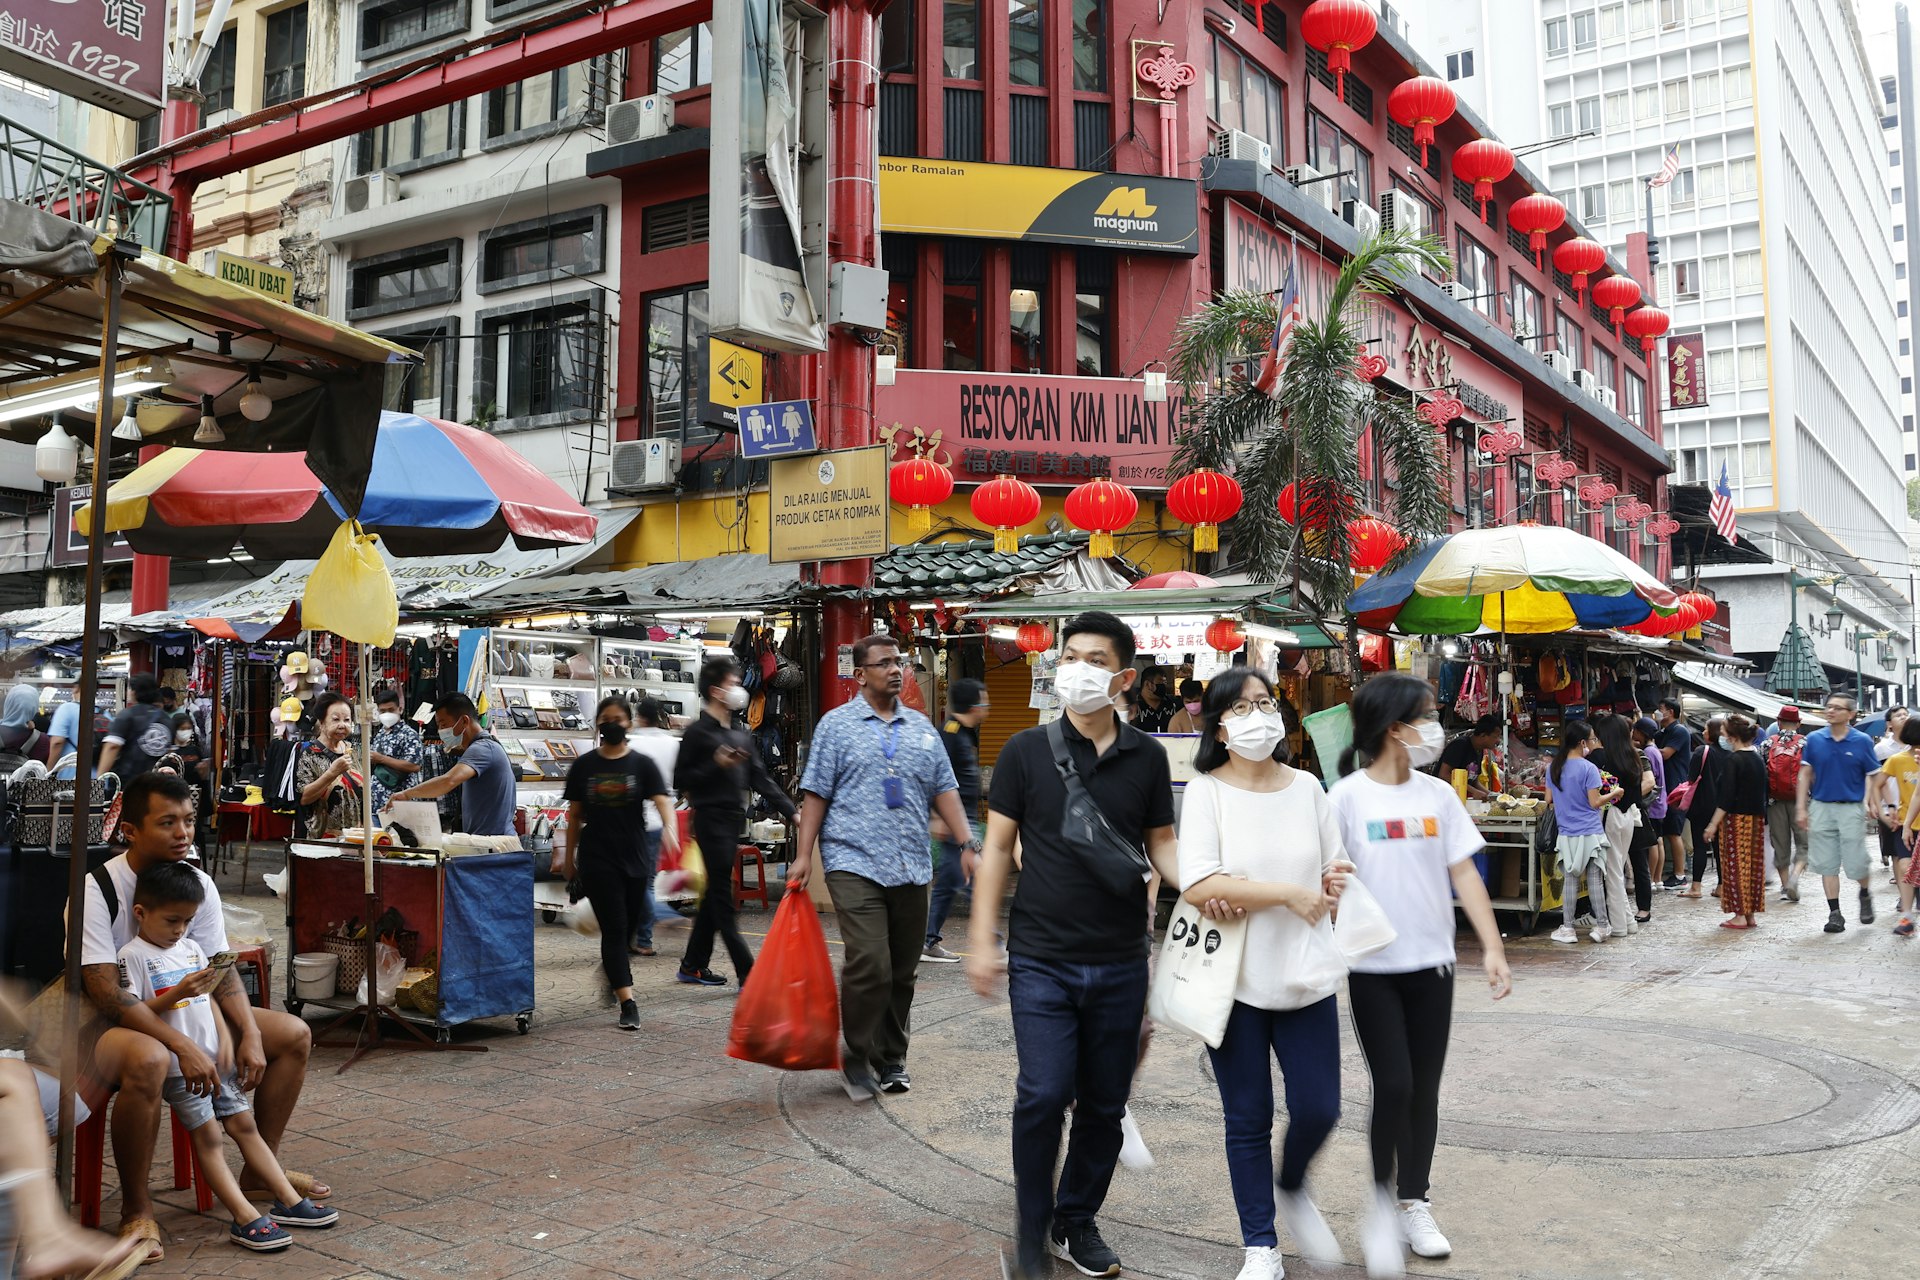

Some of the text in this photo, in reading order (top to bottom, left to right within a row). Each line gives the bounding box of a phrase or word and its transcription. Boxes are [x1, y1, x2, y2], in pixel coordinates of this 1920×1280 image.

[67, 41, 140, 85] 1927
[912, 164, 965, 176] Ramalan
[1093, 216, 1158, 233] magnum
[222, 260, 287, 295] KEDAI UBAT
[960, 384, 1060, 441] RESTORAN
[1071, 391, 1107, 443] KIM
[1116, 393, 1157, 445] LIAN
[1118, 465, 1143, 479] 創於
[70, 487, 86, 499] KEDAI
[784, 486, 872, 508] DILARANG MENJUAL
[775, 503, 882, 527] PRODUK CETAK ROMPAK
[1177, 634, 1207, 646] 豆腐花
